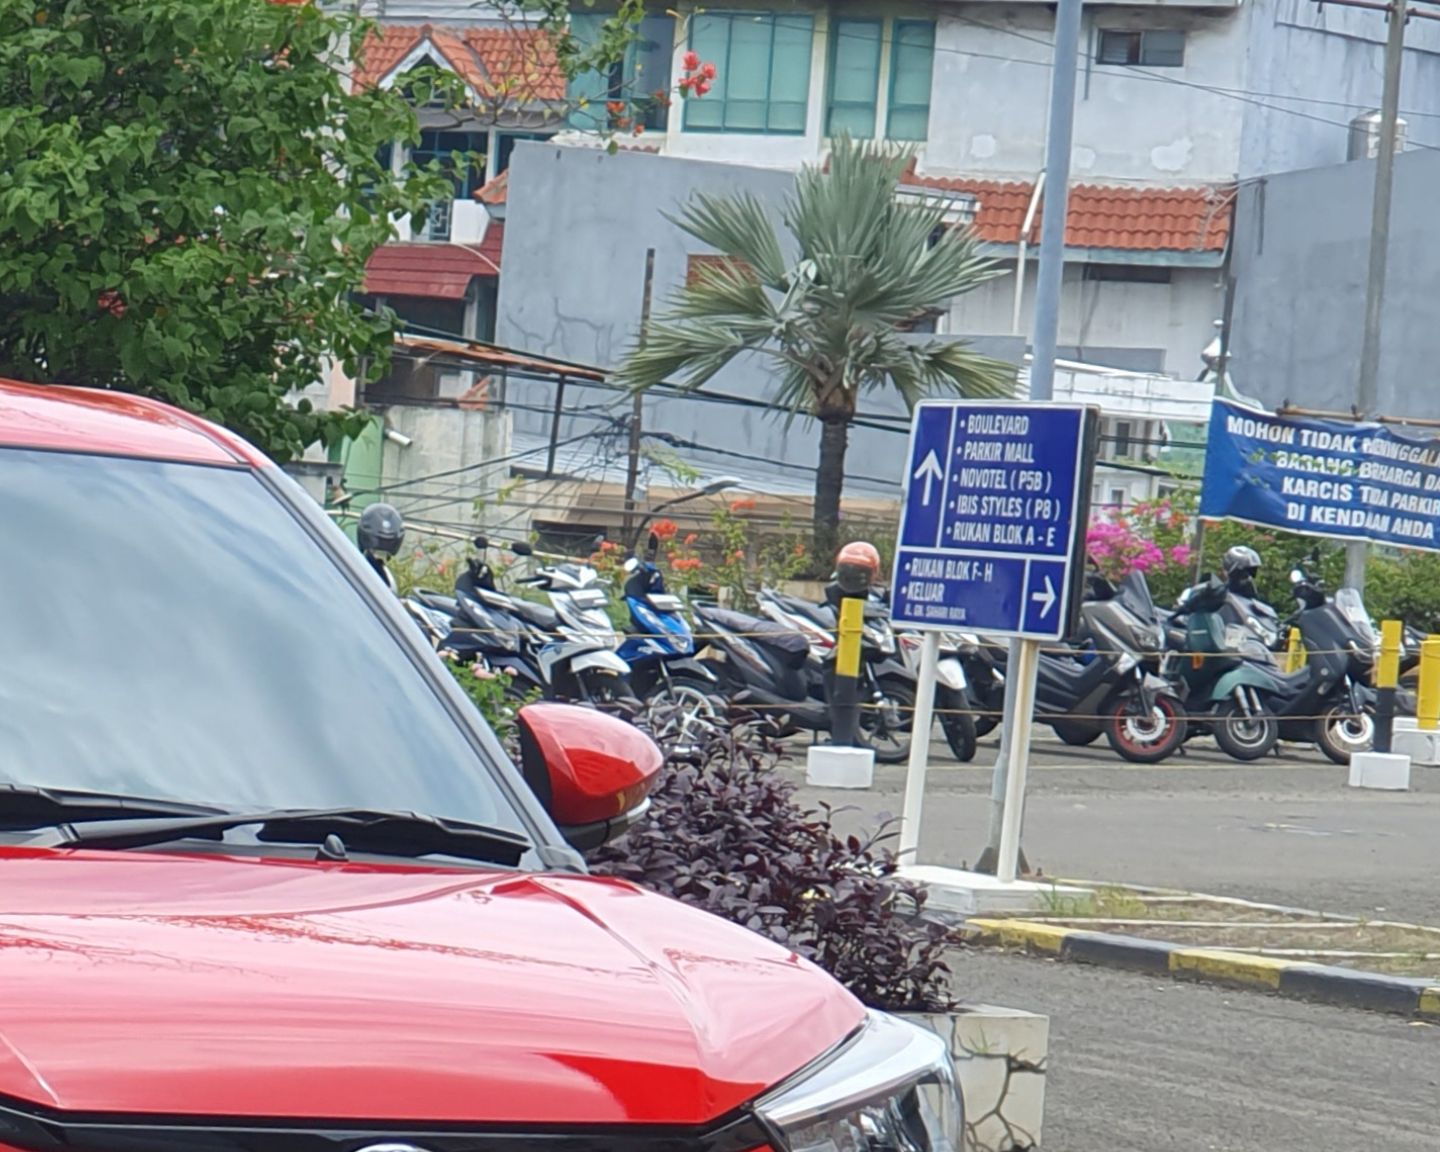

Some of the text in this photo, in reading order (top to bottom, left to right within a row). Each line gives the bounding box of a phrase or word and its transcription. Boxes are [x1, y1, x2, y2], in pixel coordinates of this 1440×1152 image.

[967, 415, 1029, 435] BOULEVARD
[1227, 415, 1294, 445] MOHON
[1301, 430, 1357, 453] TIDAK
[964, 441, 1034, 463] PARKIR MALL
[960, 468, 1007, 490] NOVOTEL
[1282, 476, 1353, 502] KARCIS
[957, 495, 978, 515] IBIS
[981, 496, 1023, 518] STYLES
[1286, 503, 1305, 522] DI
[1391, 517, 1434, 539] ANDA
[953, 521, 991, 543] RUKAN
[993, 524, 1023, 544] BLOK
[1025, 526, 1034, 546] A
[1046, 527, 1056, 547] E
[910, 557, 944, 578] RUKAN
[945, 559, 970, 581] BLOK
[984, 562, 993, 582] H
[907, 581, 945, 602] KELUAR
